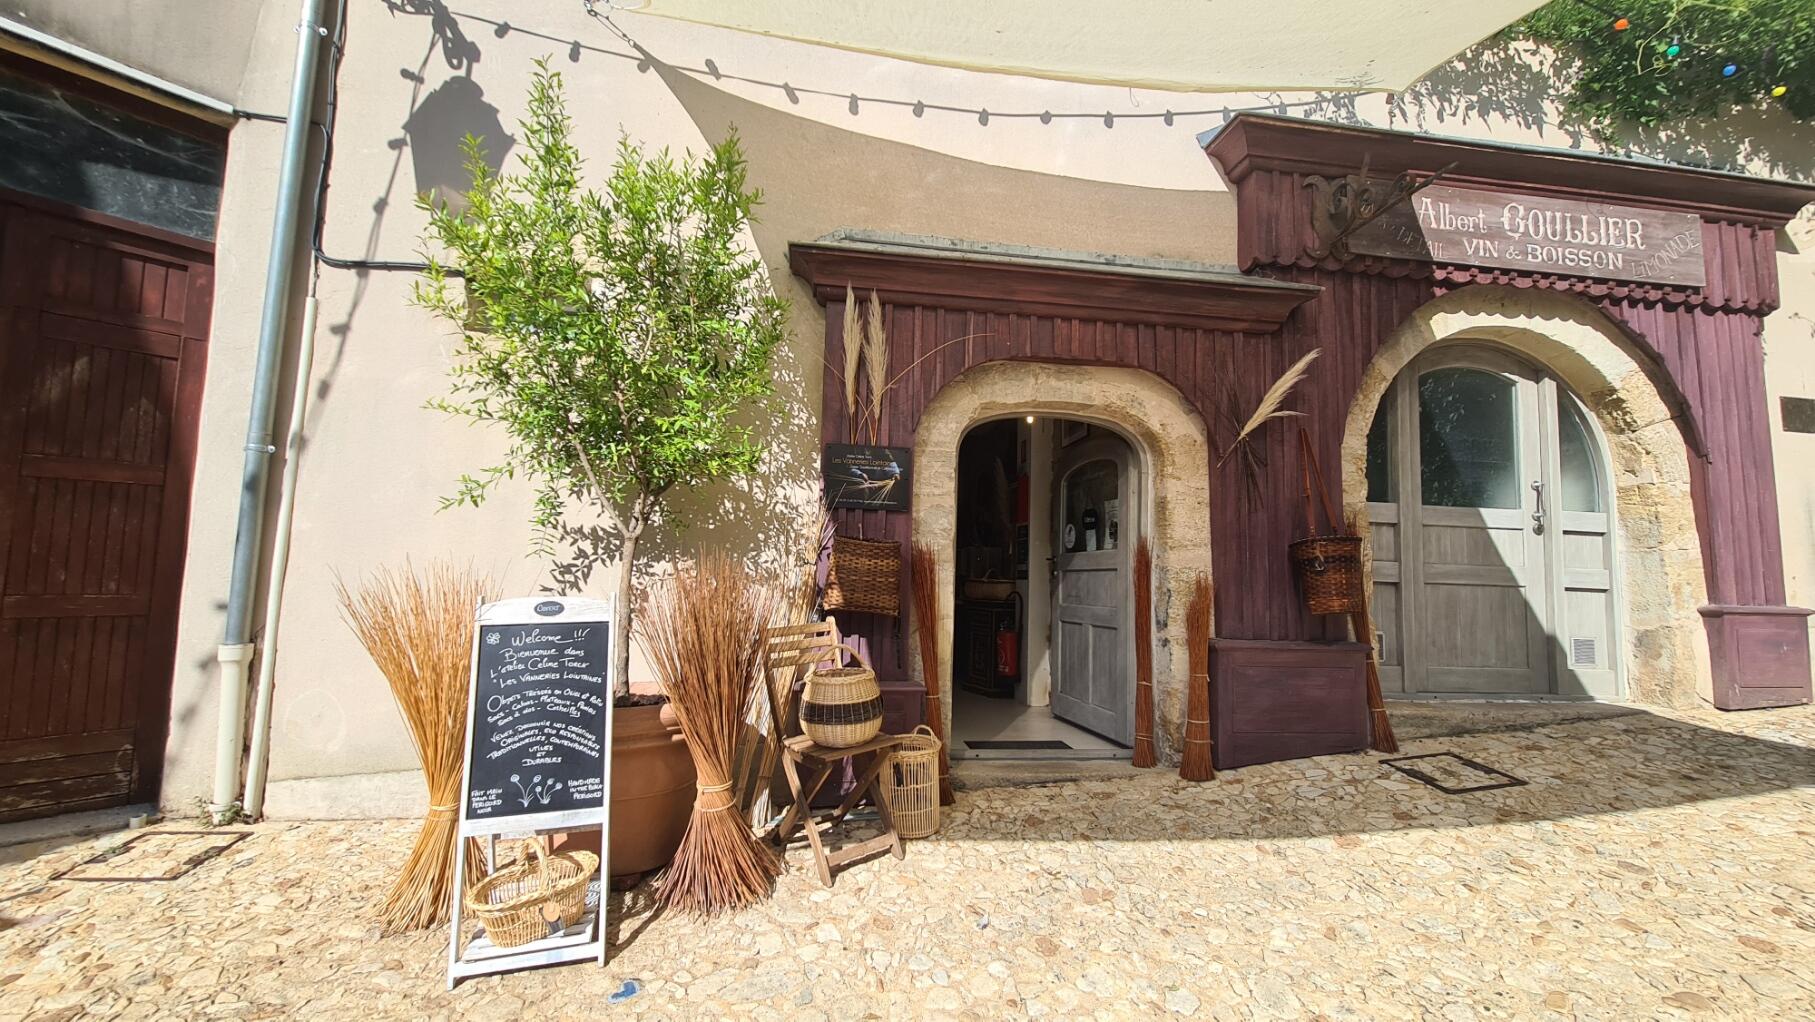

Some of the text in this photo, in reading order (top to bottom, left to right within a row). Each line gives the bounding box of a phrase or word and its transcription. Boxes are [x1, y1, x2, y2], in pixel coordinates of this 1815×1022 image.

[1419, 197, 1488, 234] Albert
[1500, 202, 1646, 250] GOULLIER
[1463, 239, 1624, 271] VIN & BOISSON
[1631, 229, 1700, 279] LIMONADE
[511, 628, 573, 646] Welcome
[564, 647, 584, 656] dans
